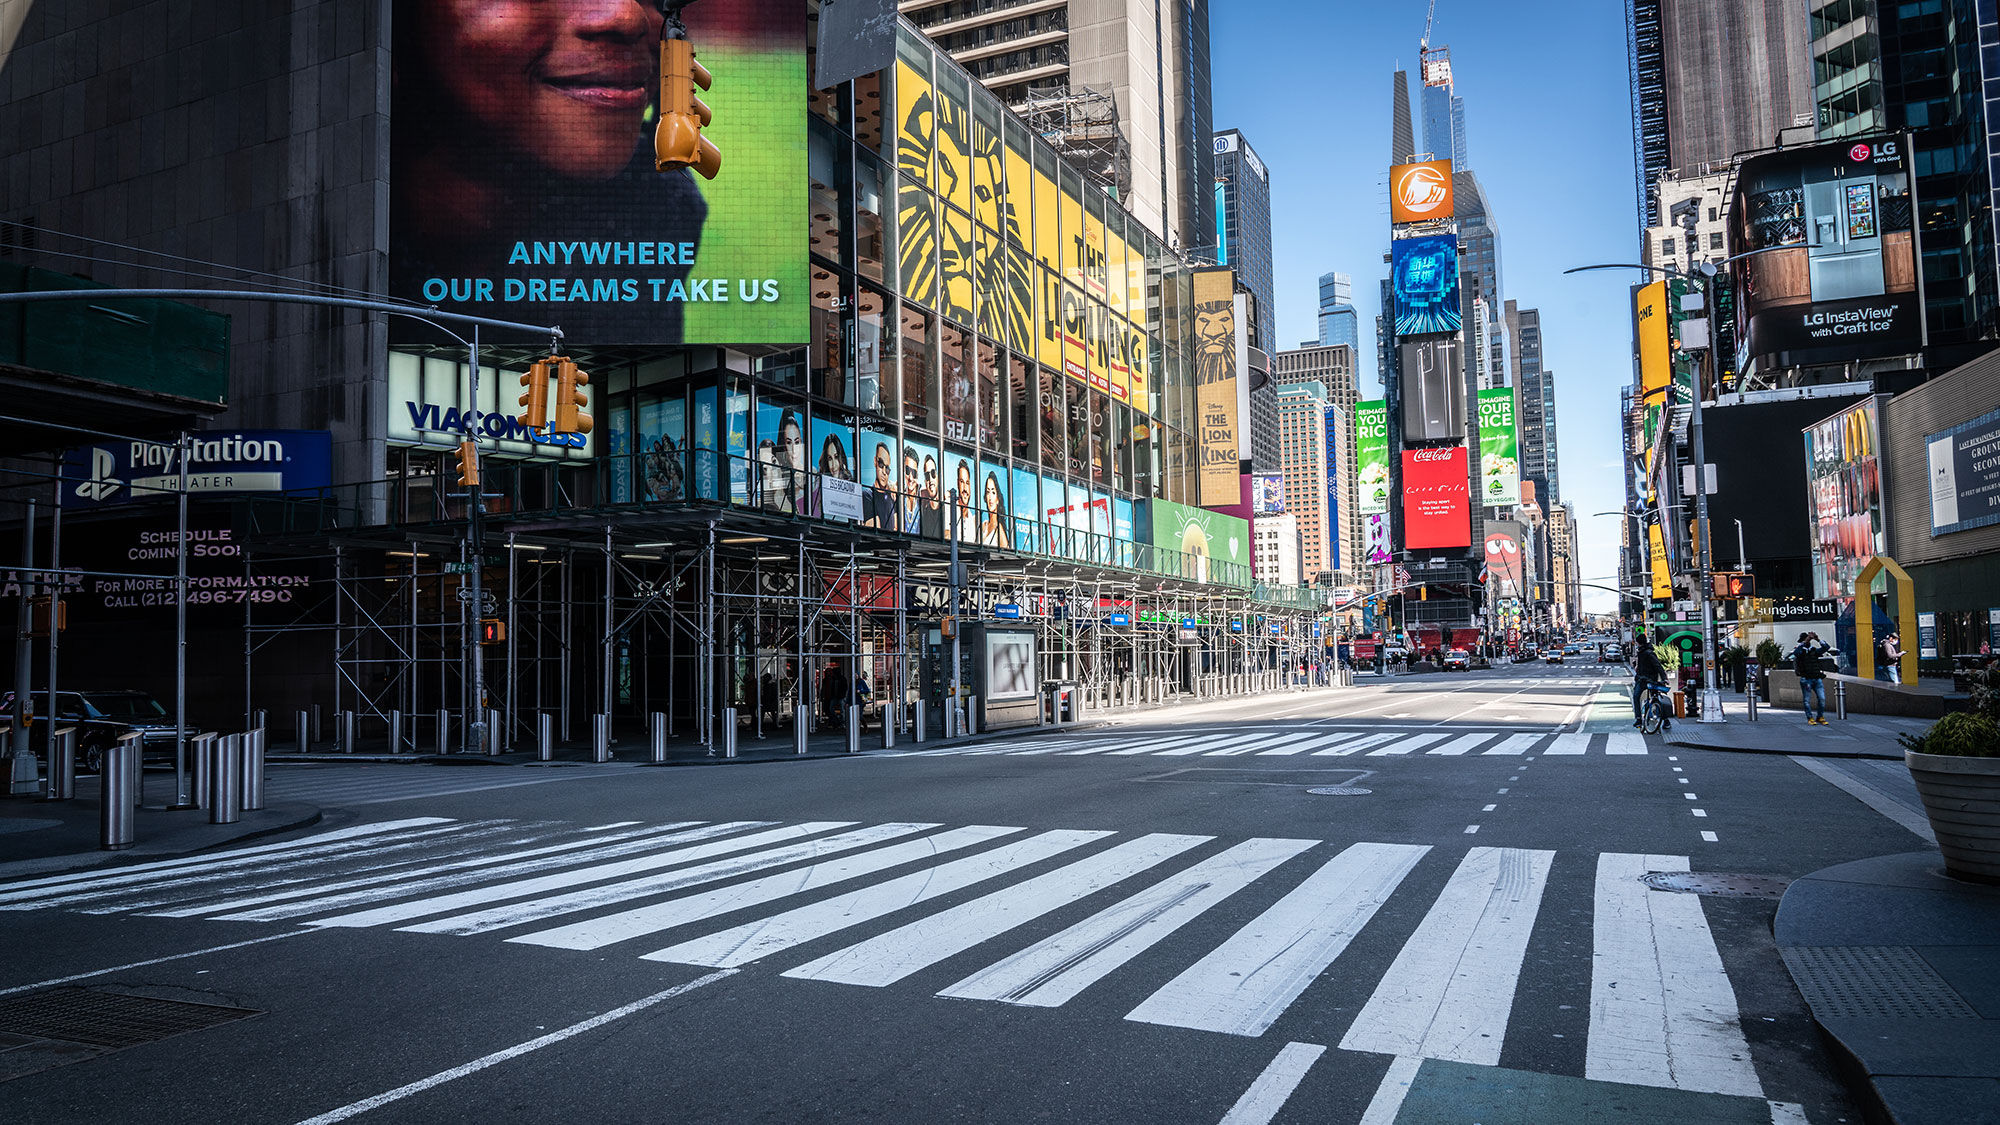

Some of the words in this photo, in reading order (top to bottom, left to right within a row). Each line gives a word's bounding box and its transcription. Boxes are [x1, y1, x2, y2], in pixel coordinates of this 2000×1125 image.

[1873, 141, 1896, 157] LG
[508, 241, 695, 265] ANYWHERE
[1074, 234, 1105, 286] THE
[422, 277, 494, 302] OUR
[504, 278, 639, 302] DREAMS
[648, 278, 729, 302] TAKE
[738, 278, 780, 302] US
[1042, 255, 1095, 346] LION
[1096, 293, 1143, 374] KING
[1803, 313, 1824, 327] LG
[1811, 328, 1832, 337] with
[1833, 321, 1868, 335] Craft
[1478, 395, 1511, 405] EIMAGINE
[1205, 414, 1227, 425] THE
[1202, 427, 1232, 444] LION
[1359, 424, 1387, 439] RIC
[1327, 417, 1337, 470] NOVOTEL
[1201, 446, 1237, 467] KING
[160, 476, 234, 490] THATER
[95, 580, 122, 593] FOR
[124, 579, 165, 592] MORE
[104, 594, 139, 608] CALL
[187, 589, 293, 605] 496-7490
[1757, 603, 1810, 618] sunglass
[1812, 602, 1834, 614] hut
